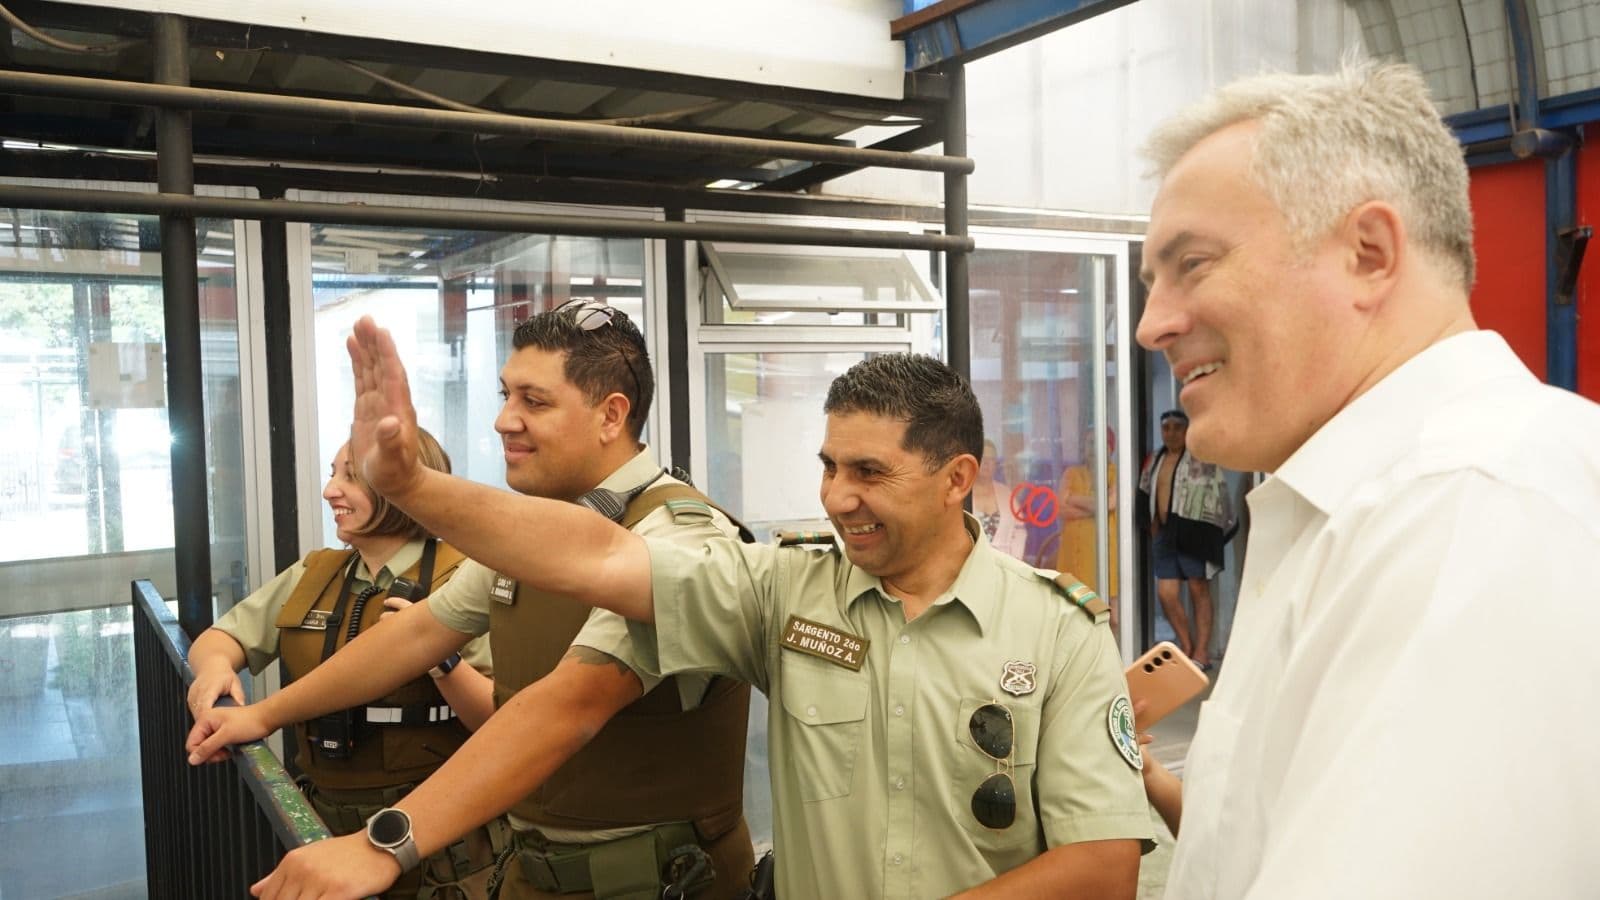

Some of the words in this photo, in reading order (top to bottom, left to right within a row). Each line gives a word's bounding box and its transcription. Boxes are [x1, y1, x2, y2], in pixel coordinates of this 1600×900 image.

[786, 632, 797, 644] J.
[799, 636, 844, 659] MUÑOZ
[844, 652, 856, 664] A.
[792, 621, 841, 643] SARGENTO
[843, 638, 861, 652] 2do
